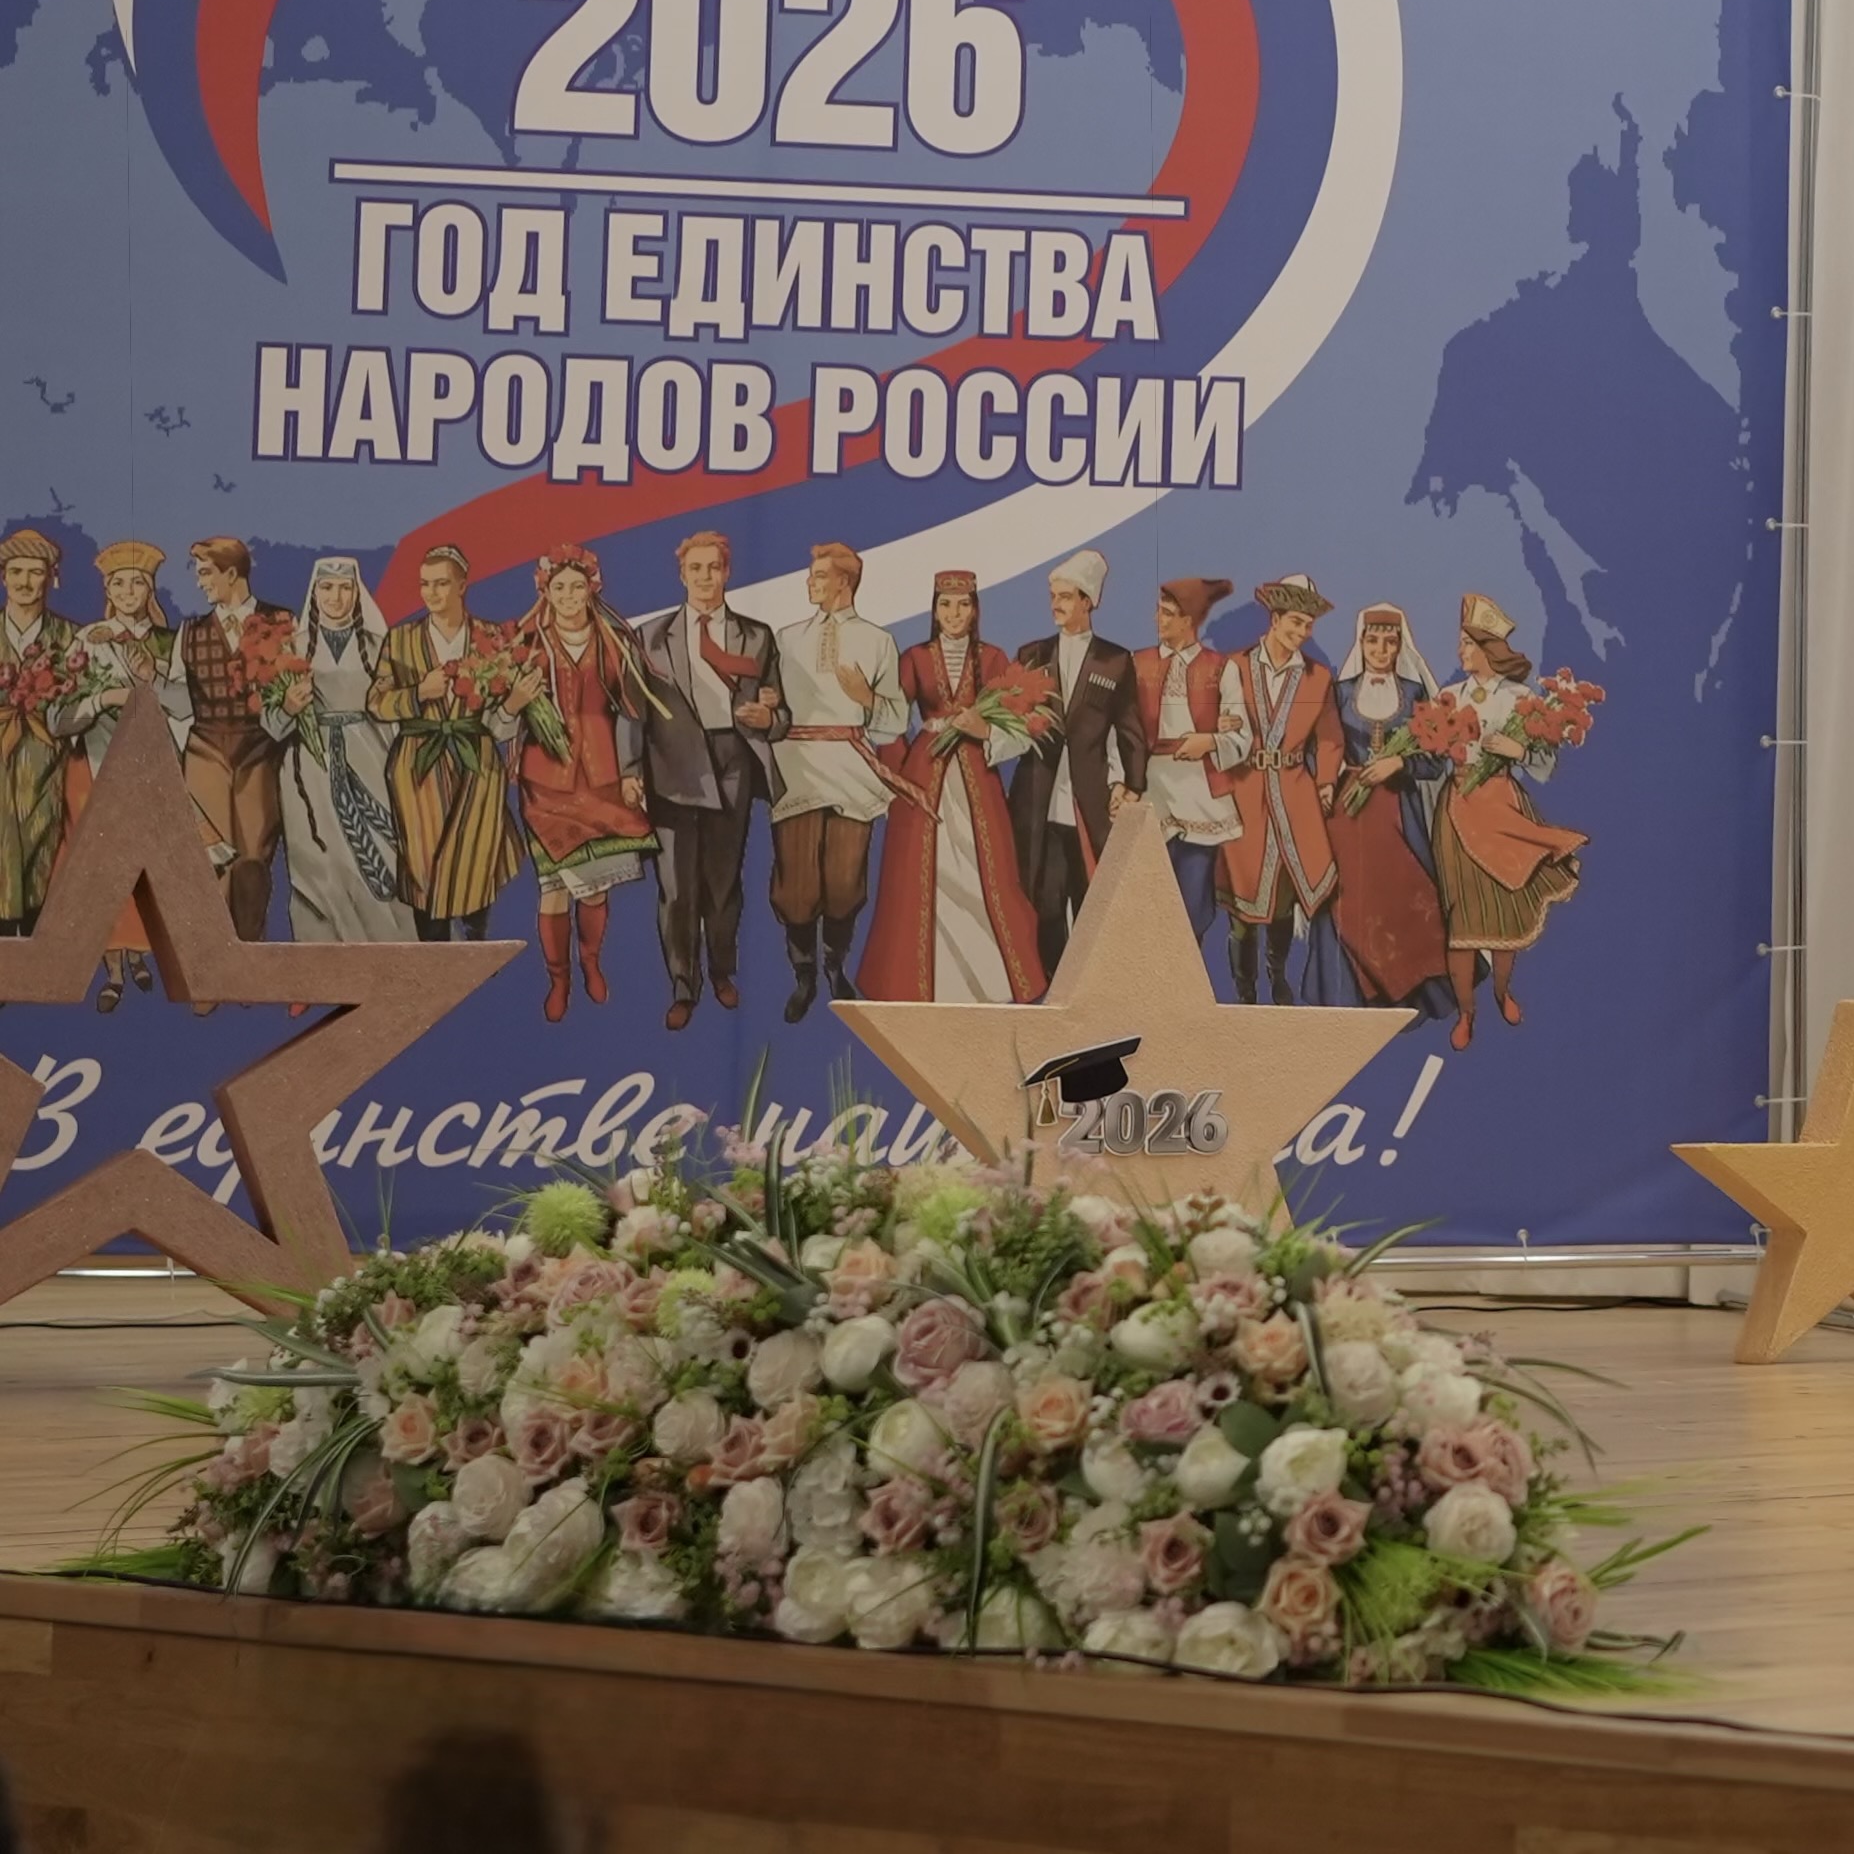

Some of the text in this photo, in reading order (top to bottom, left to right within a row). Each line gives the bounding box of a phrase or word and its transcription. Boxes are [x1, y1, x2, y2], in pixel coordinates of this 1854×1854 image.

[352, 197, 1160, 343] ГОД ЕДИНСТВА
[252, 342, 1246, 490] НАРОДОВ РОССИИ
[1058, 1090, 1229, 1155] 2026
